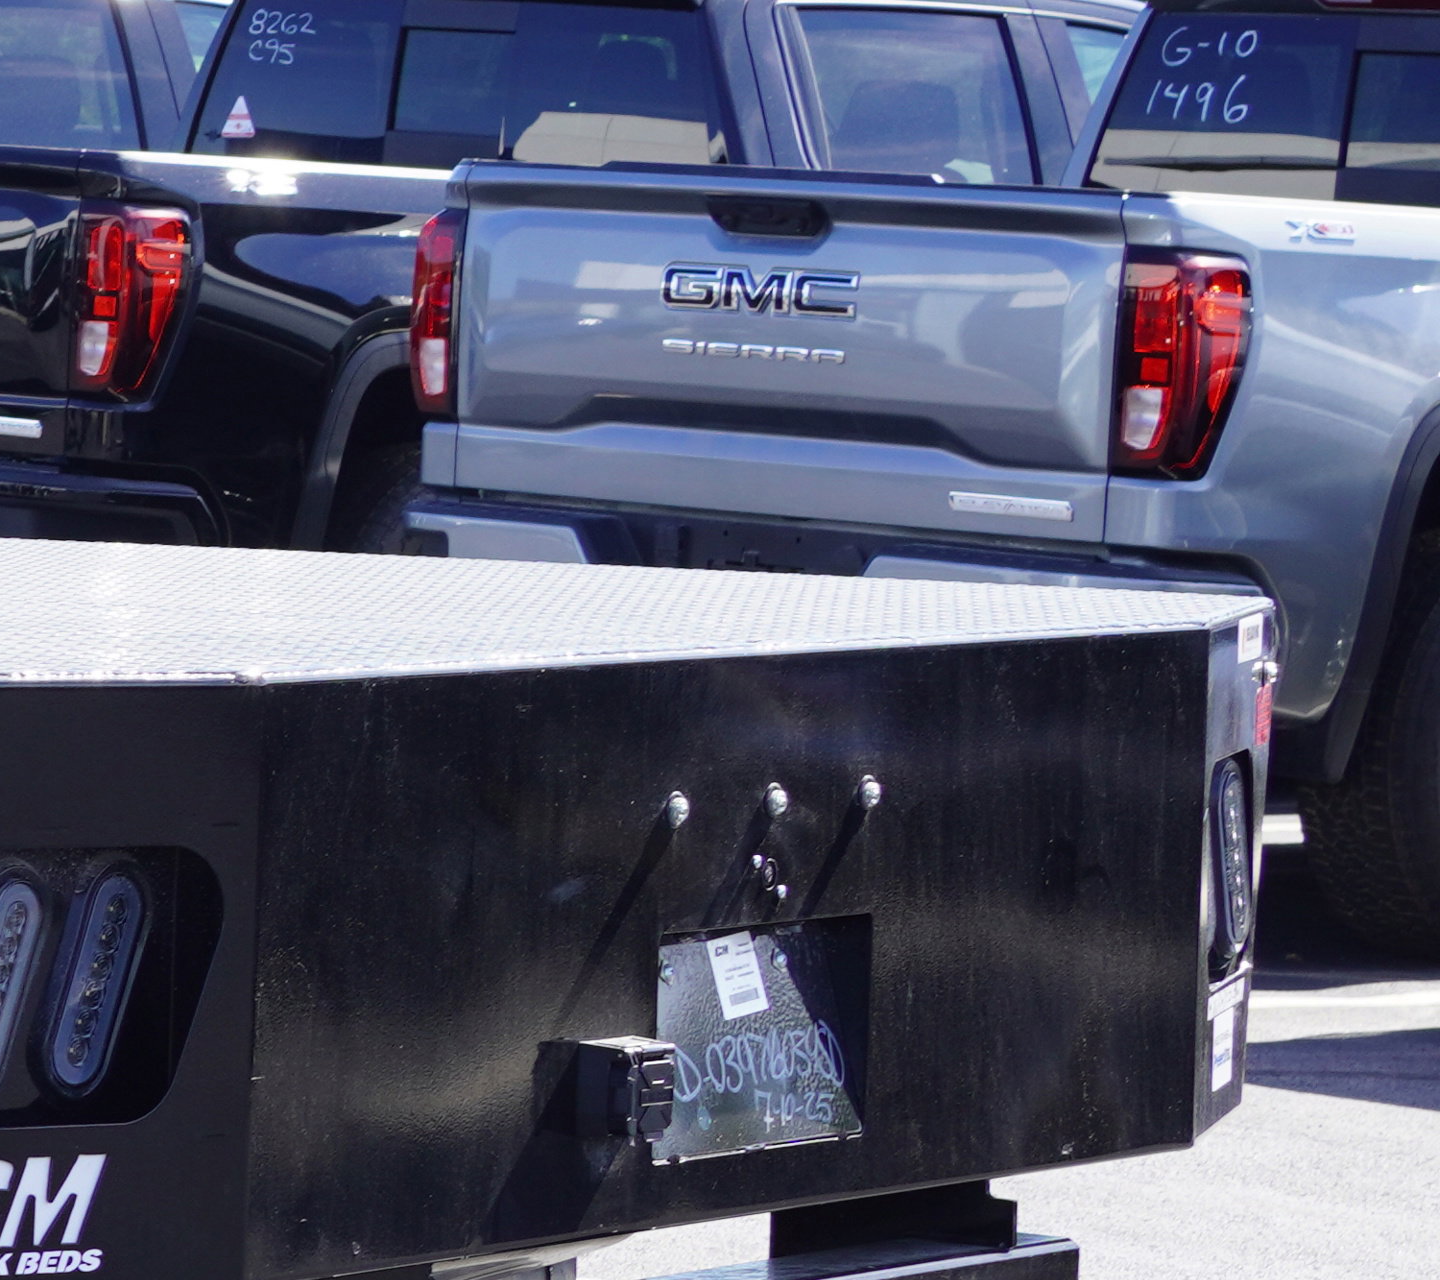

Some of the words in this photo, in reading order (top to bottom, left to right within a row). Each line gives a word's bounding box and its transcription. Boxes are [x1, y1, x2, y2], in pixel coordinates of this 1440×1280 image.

[248, 8, 317, 35] 8262
[248, 38, 296, 65] C95
[1161, 26, 1258, 67] G-10
[1146, 74, 1249, 124] 1496
[661, 261, 861, 322] GMC
[662, 338, 847, 364] SIERRA
[15, 1248, 104, 1276] BEDS
